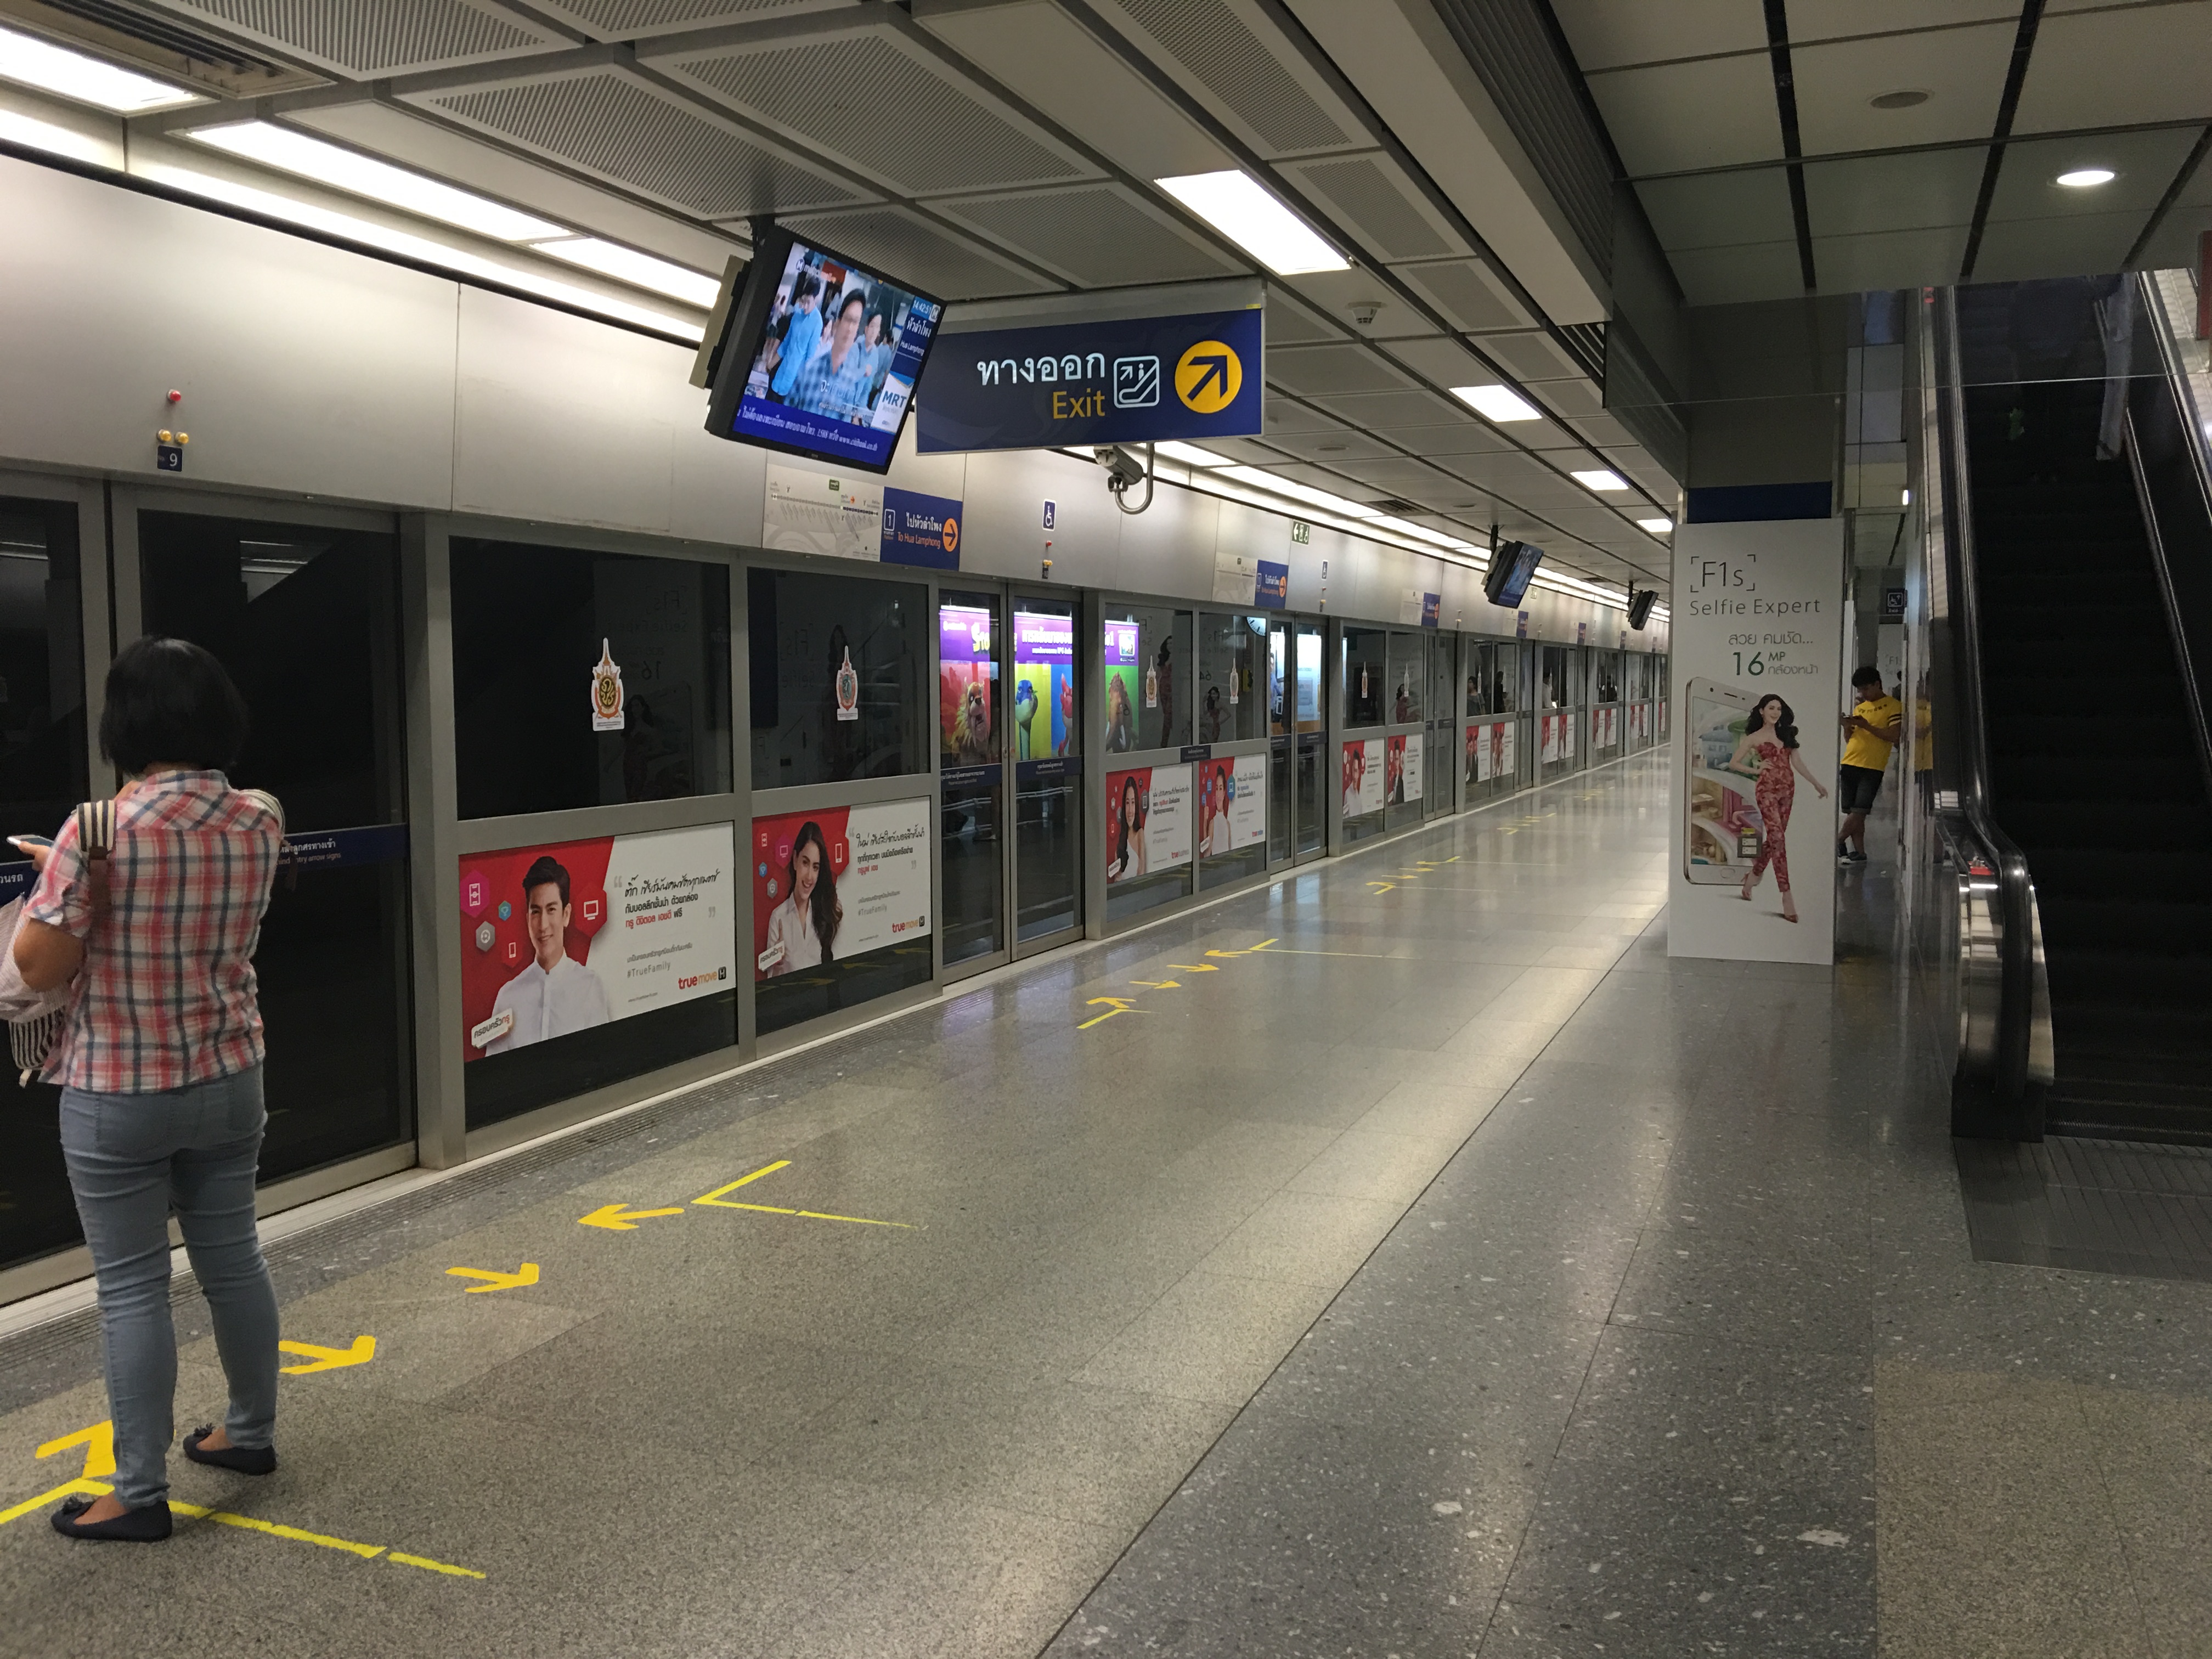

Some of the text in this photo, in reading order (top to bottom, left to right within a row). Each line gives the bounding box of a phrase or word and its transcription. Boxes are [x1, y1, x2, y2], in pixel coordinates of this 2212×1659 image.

[906, 317, 932, 338] หัวลำโพง
[977, 352, 1105, 386] ทางออก
[882, 390, 907, 409] MRT
[1053, 388, 1105, 419] Exit
[170, 453, 177, 467] 9
[906, 511, 942, 532] ไปหัวลำโพง
[898, 532, 904, 542] To
[904, 533, 915, 544] Hua
[915, 534, 941, 550] Lamphong
[1701, 561, 1743, 587] F1s
[1689, 599, 1821, 617] Selfie Expert
[1728, 634, 1757, 645] สวย
[1733, 651, 1786, 676] 16 MP
[1768, 664, 1819, 675] กล้องหน้า
[308, 854, 326, 864] arrow
[326, 852, 341, 861] signs
[625, 892, 698, 914] กับบอลลีกชั้นนำ ด้วยกล่อง
[625, 907, 683, 929] ทรู ดิจิตอล เอชดี ฟรี
[627, 961, 671, 979] #TrueFamily
[474, 1014, 510, 1039] ครอบครัวทรู
